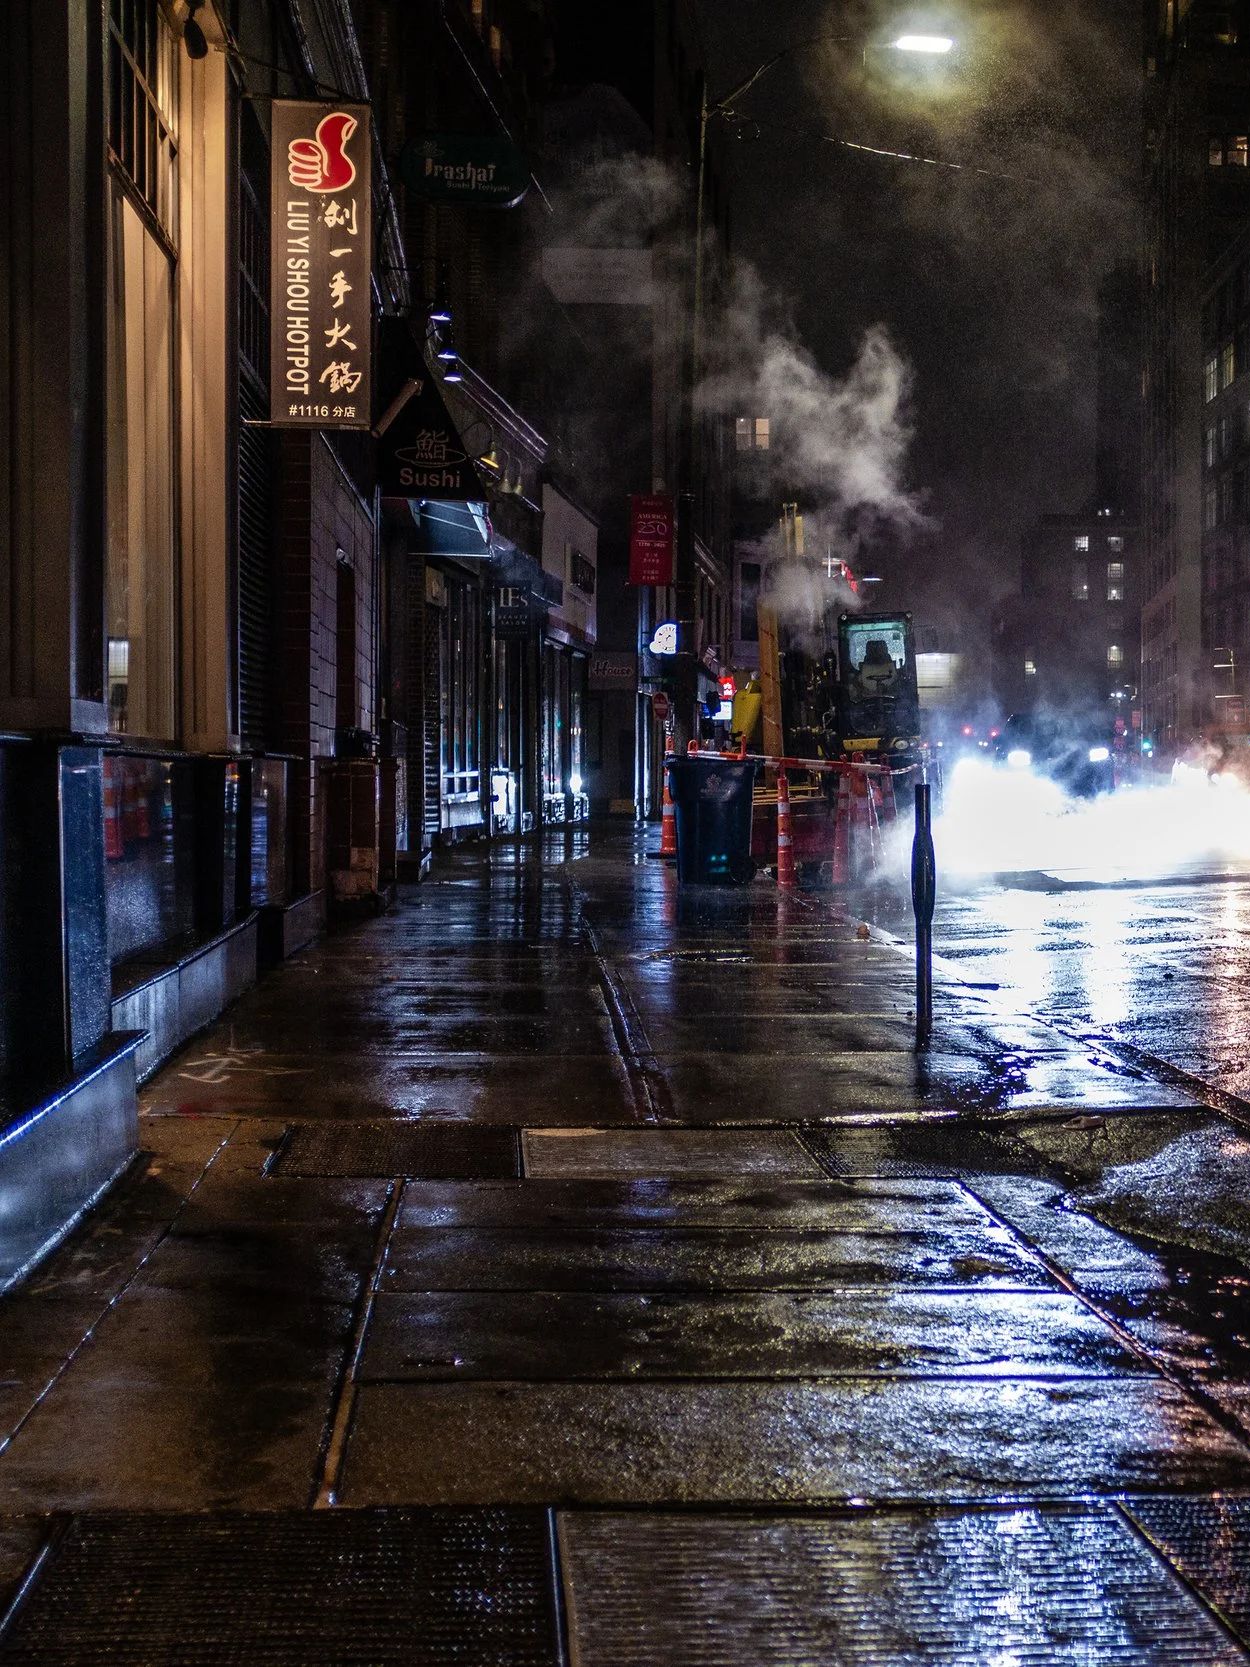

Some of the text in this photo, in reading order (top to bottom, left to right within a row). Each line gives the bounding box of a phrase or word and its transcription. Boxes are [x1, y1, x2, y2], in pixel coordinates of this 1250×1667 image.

[286, 201, 309, 395] LIU YI SHOU HOTPOT
[288, 405, 356, 418] #1116 分店
[399, 467, 461, 489] Sushi
[594, 661, 633, 676] House
